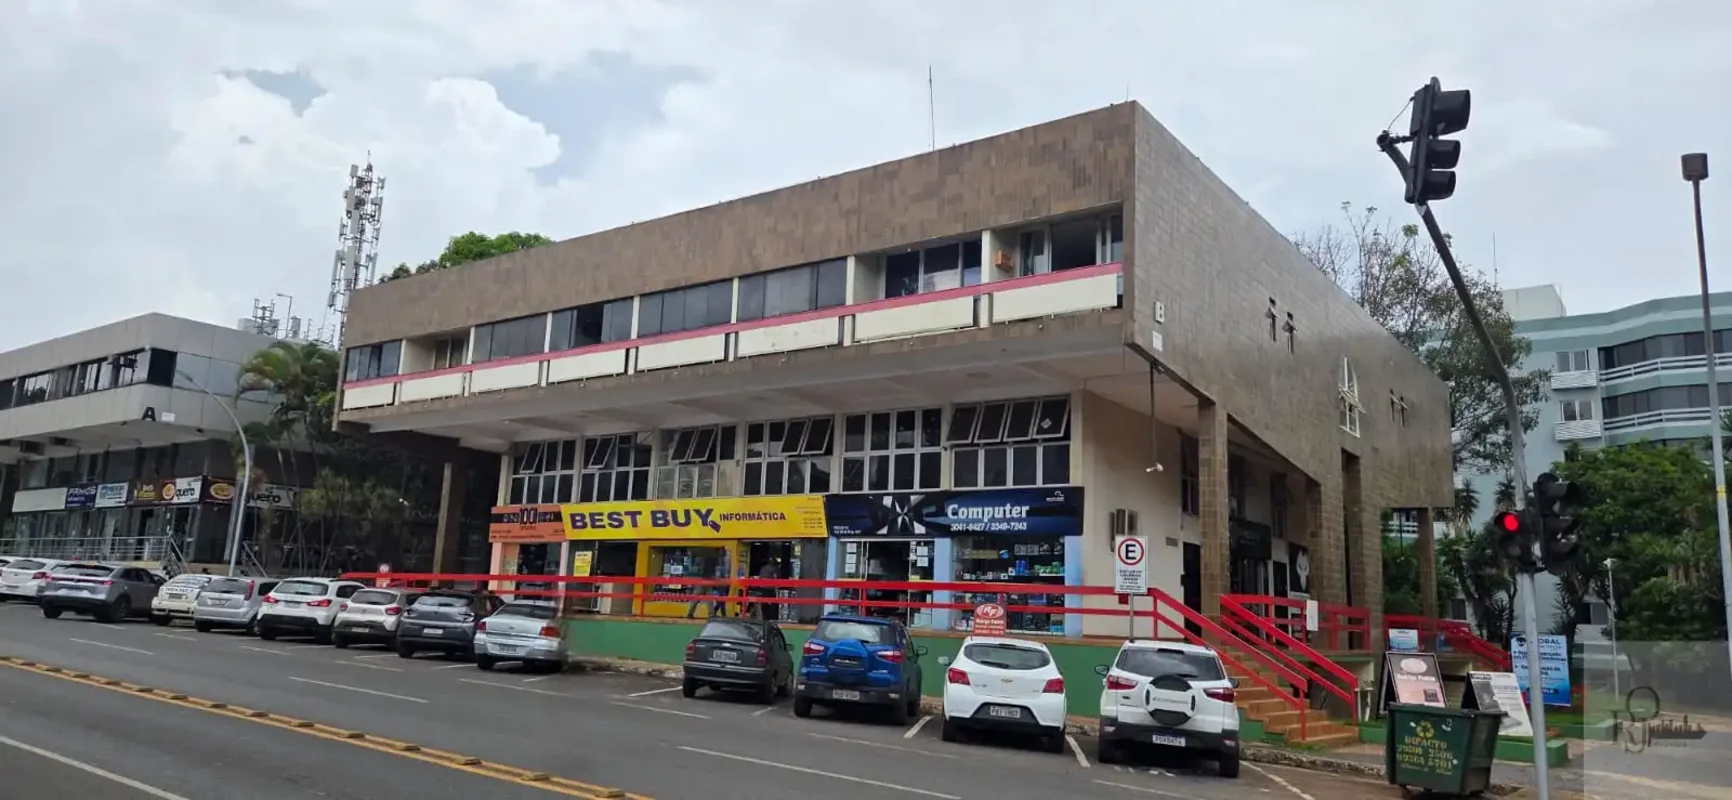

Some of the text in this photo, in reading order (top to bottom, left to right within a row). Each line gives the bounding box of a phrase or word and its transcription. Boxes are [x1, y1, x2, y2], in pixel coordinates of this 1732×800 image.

[1155, 301, 1164, 323] B
[141, 406, 157, 421] A
[569, 511, 643, 530] BEST
[650, 508, 714, 528] BUY
[719, 511, 787, 522] INFORMÁTICA
[946, 502, 1030, 522] Computer
[1125, 544, 1137, 560] E
